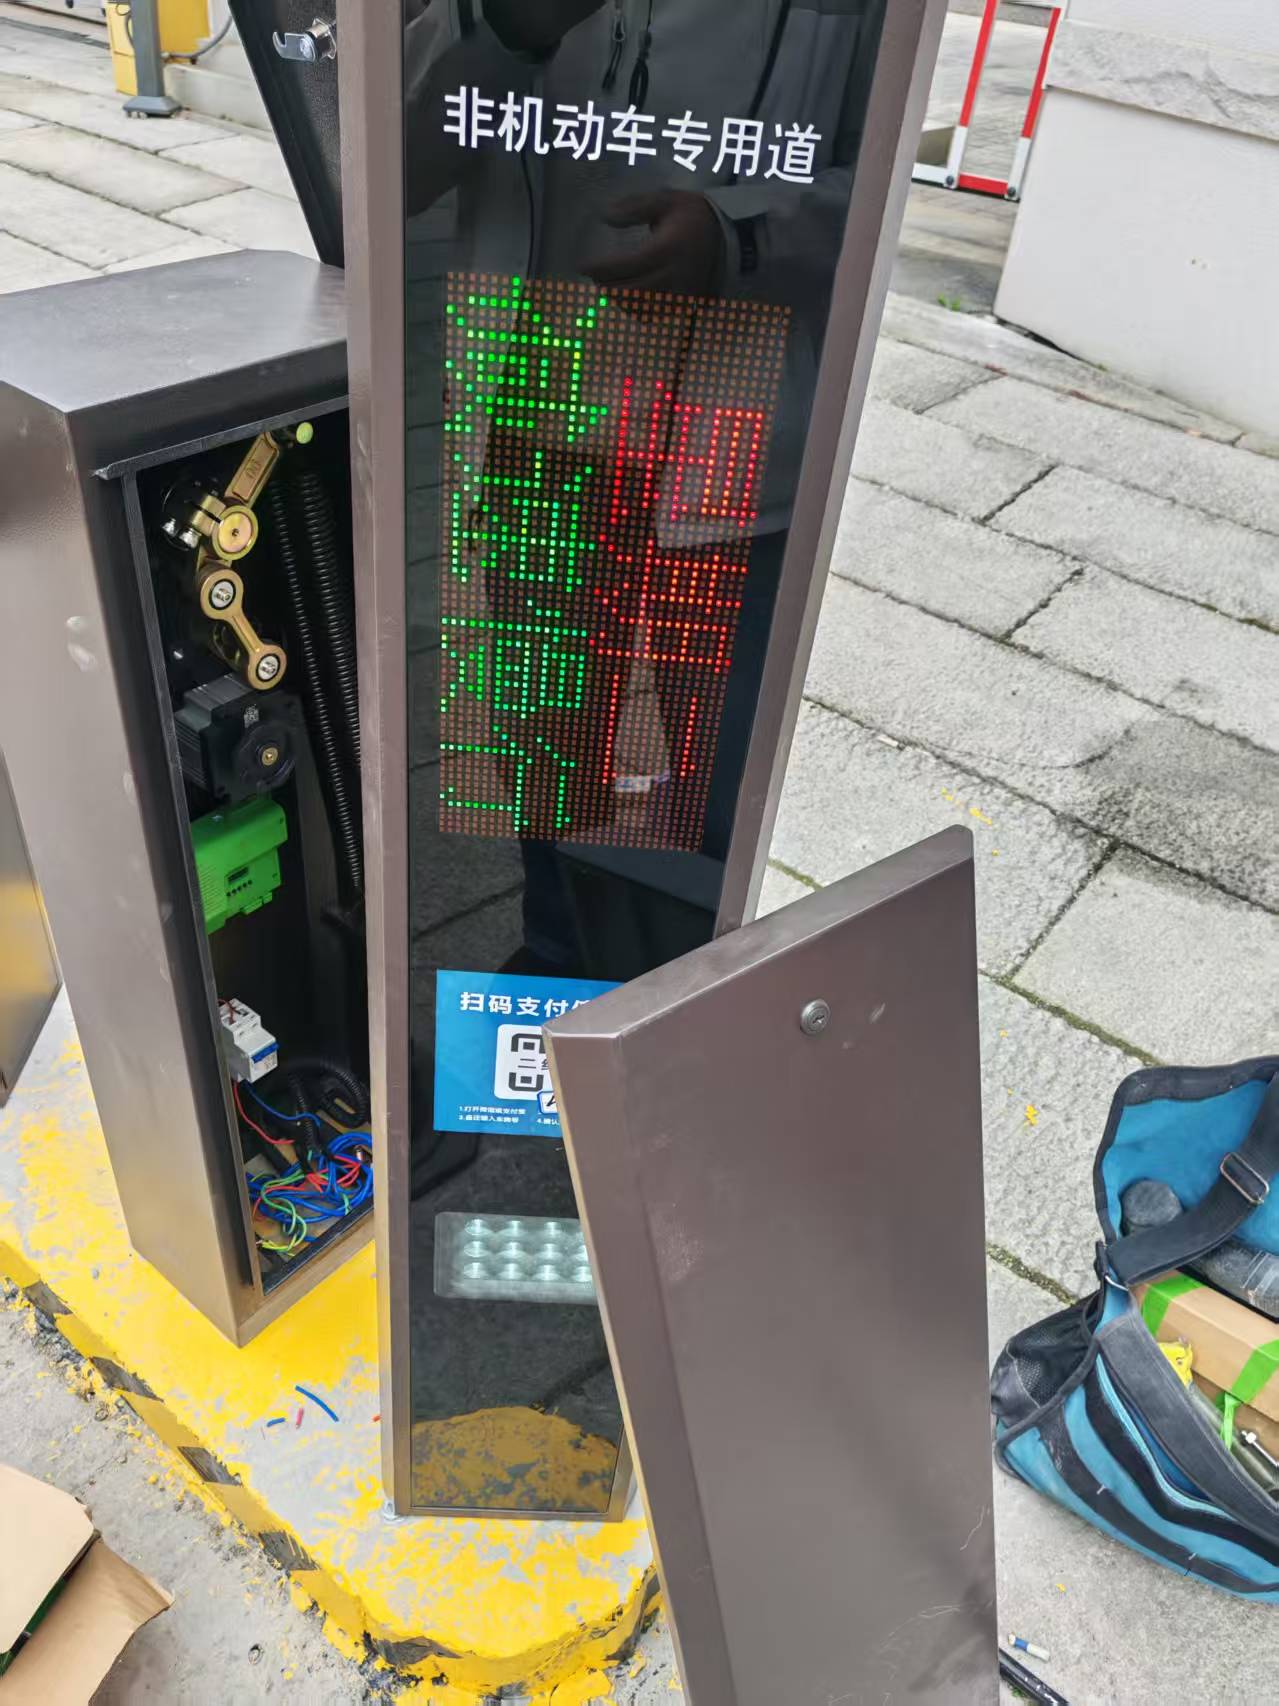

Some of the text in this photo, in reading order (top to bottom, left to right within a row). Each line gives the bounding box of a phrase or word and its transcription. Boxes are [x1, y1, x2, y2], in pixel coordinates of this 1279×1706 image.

[443, 85, 823, 184] 非机动车专用道
